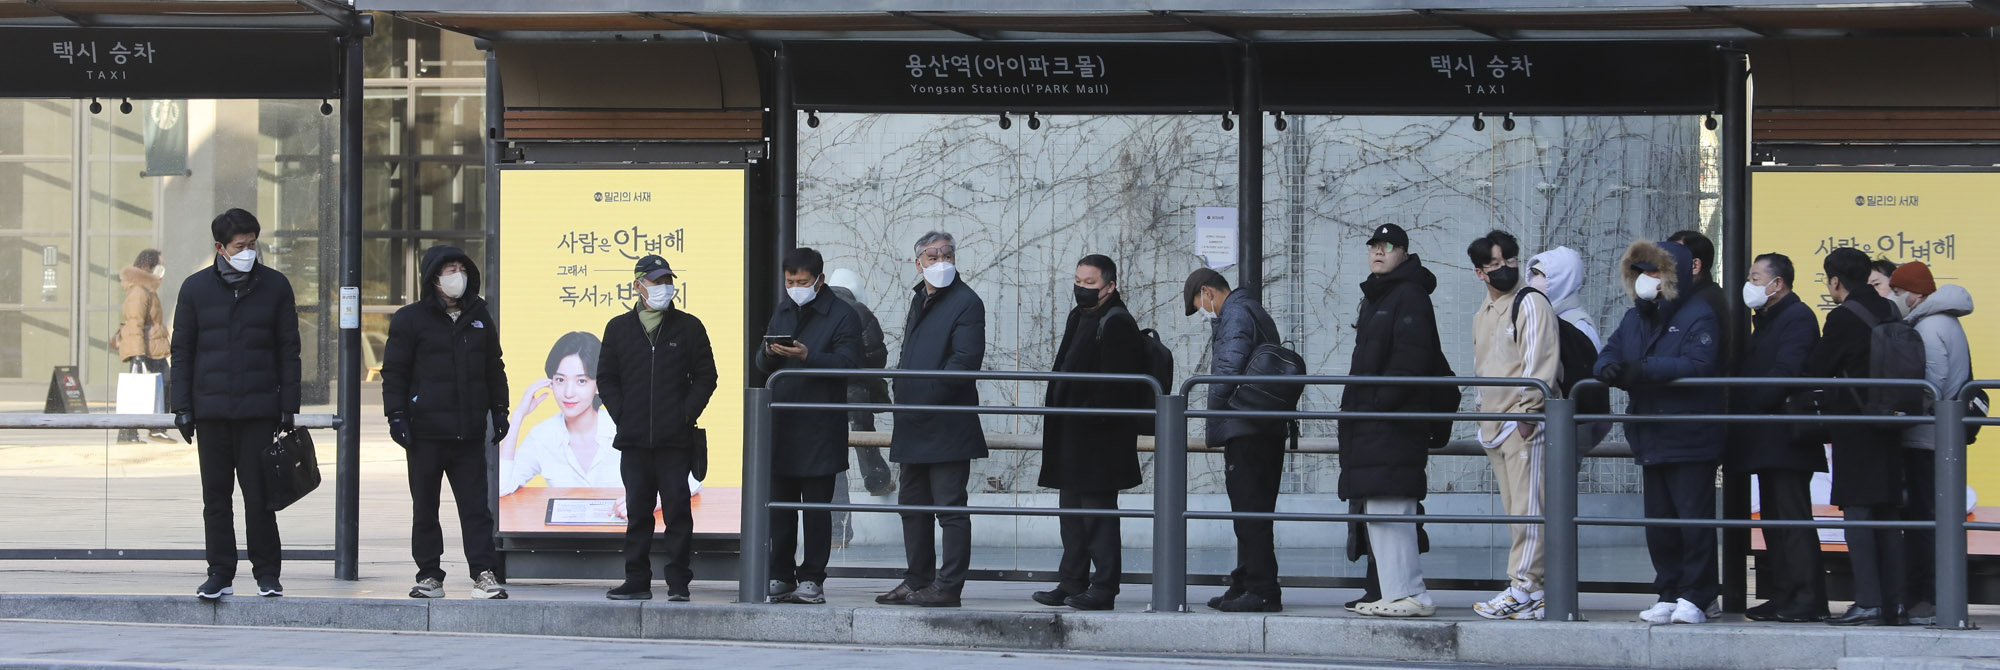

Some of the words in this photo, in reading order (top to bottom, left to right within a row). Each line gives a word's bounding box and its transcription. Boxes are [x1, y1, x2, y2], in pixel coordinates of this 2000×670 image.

[52, 41, 97, 65] 택시
[109, 41, 156, 65] 승차
[905, 54, 1106, 78] 용산역(아이파크몰)
[1430, 54, 1475, 79] 택시
[1486, 54, 1533, 79] 승차
[86, 70, 127, 80] TAXI
[910, 84, 965, 95] Yongsan
[1076, 84, 1110, 95] Mall)
[1465, 84, 1505, 95] TAXI
[604, 191, 631, 202] 밀리의
[633, 191, 651, 202] 서재
[1866, 195, 1896, 207] 밀리의
[1898, 195, 1919, 207] 서재
[557, 231, 612, 254] 사람은
[557, 264, 588, 277] 그래서
[559, 284, 613, 308] 독서가
